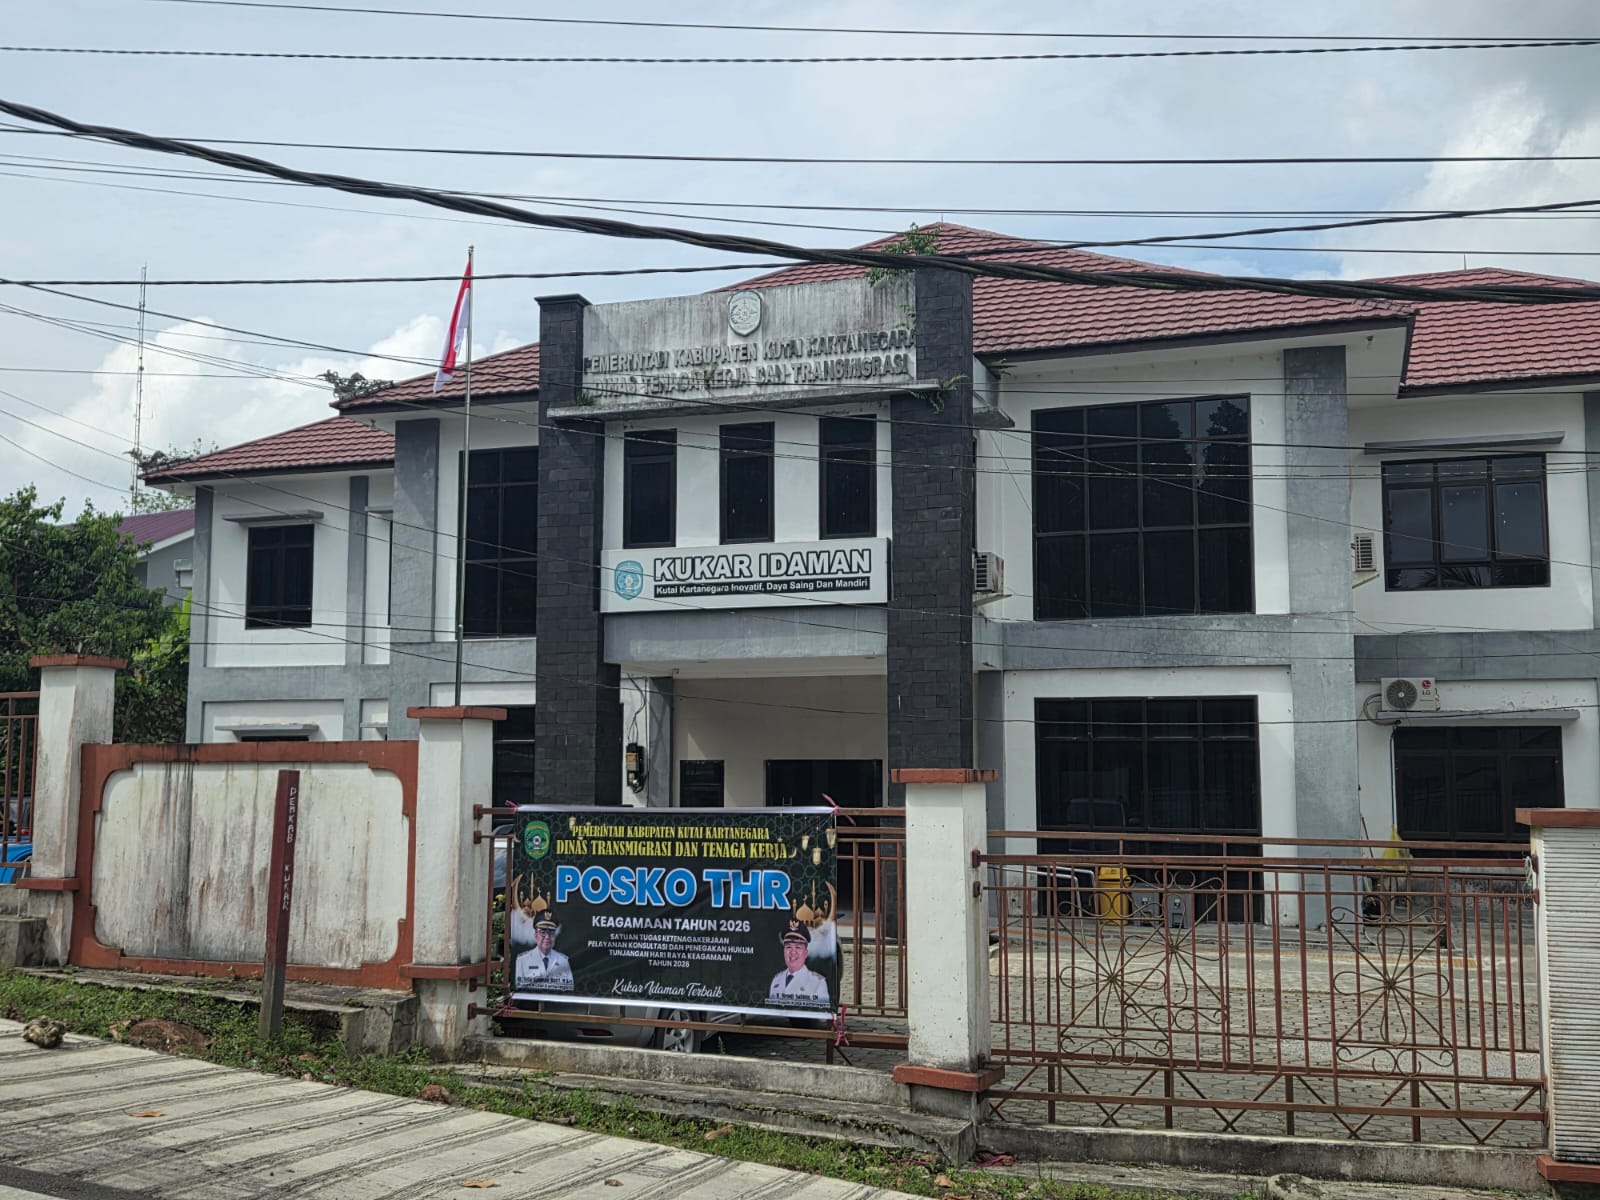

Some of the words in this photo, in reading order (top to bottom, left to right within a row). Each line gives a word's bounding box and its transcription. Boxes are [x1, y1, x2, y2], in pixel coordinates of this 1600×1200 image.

[673, 343, 757, 368] KABUPATEN
[763, 337, 803, 360] KUTAI
[756, 362, 788, 384] DAN
[791, 353, 909, 384] TRANSMIGRASI
[654, 553, 753, 581] KUKAR
[759, 548, 872, 577] IDAMAN
[655, 583, 678, 595] Kutai
[679, 582, 730, 596] Kartanegara
[731, 581, 763, 593] Inovatif,
[766, 582, 788, 593] Daya
[789, 580, 815, 591] Saing
[816, 579, 833, 589] Dan
[835, 577, 869, 588] Mandiri
[286, 787, 298, 844] PEMKAB
[571, 824, 625, 838] PEMERINTAH
[626, 825, 675, 839] KABUPATEN
[677, 826, 703, 839] KUTAI
[705, 826, 770, 840] KARTANEGARA
[556, 839, 588, 855] DINAS
[590, 840, 672, 857] TRANSMIGRASI
[675, 842, 698, 858] DAN
[701, 843, 747, 859] TENAGA
[749, 843, 789, 860] KERJA
[282, 863, 292, 911] KUKAR
[556, 865, 697, 908] POSKO
[702, 869, 792, 910] THR
[592, 915, 673, 930] KEAGAMAAN
[674, 918, 718, 931] TAHUN
[719, 920, 751, 932] 2026
[587, 940, 627, 949] PELAYANAN
[628, 941, 668, 951] KONSULTASI
[669, 943, 684, 951] DAN
[685, 944, 727, 953] PENEGAKAN
[728, 946, 754, 955] HUKUM
[610, 933, 639, 942] SATUAN
[640, 934, 662, 942] TUGAS
[662, 934, 730, 944] KETENAGAKERJAAN
[609, 949, 649, 958] TUNJANGAN
[650, 950, 667, 959] HARI
[667, 951, 687, 960] RAYA
[687, 952, 732, 962] KEAGAMAAN
[649, 959, 673, 967] TAHUN
[673, 960, 690, 968] 2026
[611, 978, 645, 995] Kukar
[646, 979, 685, 997] Idaman
[685, 982, 724, 999] Terbaik
